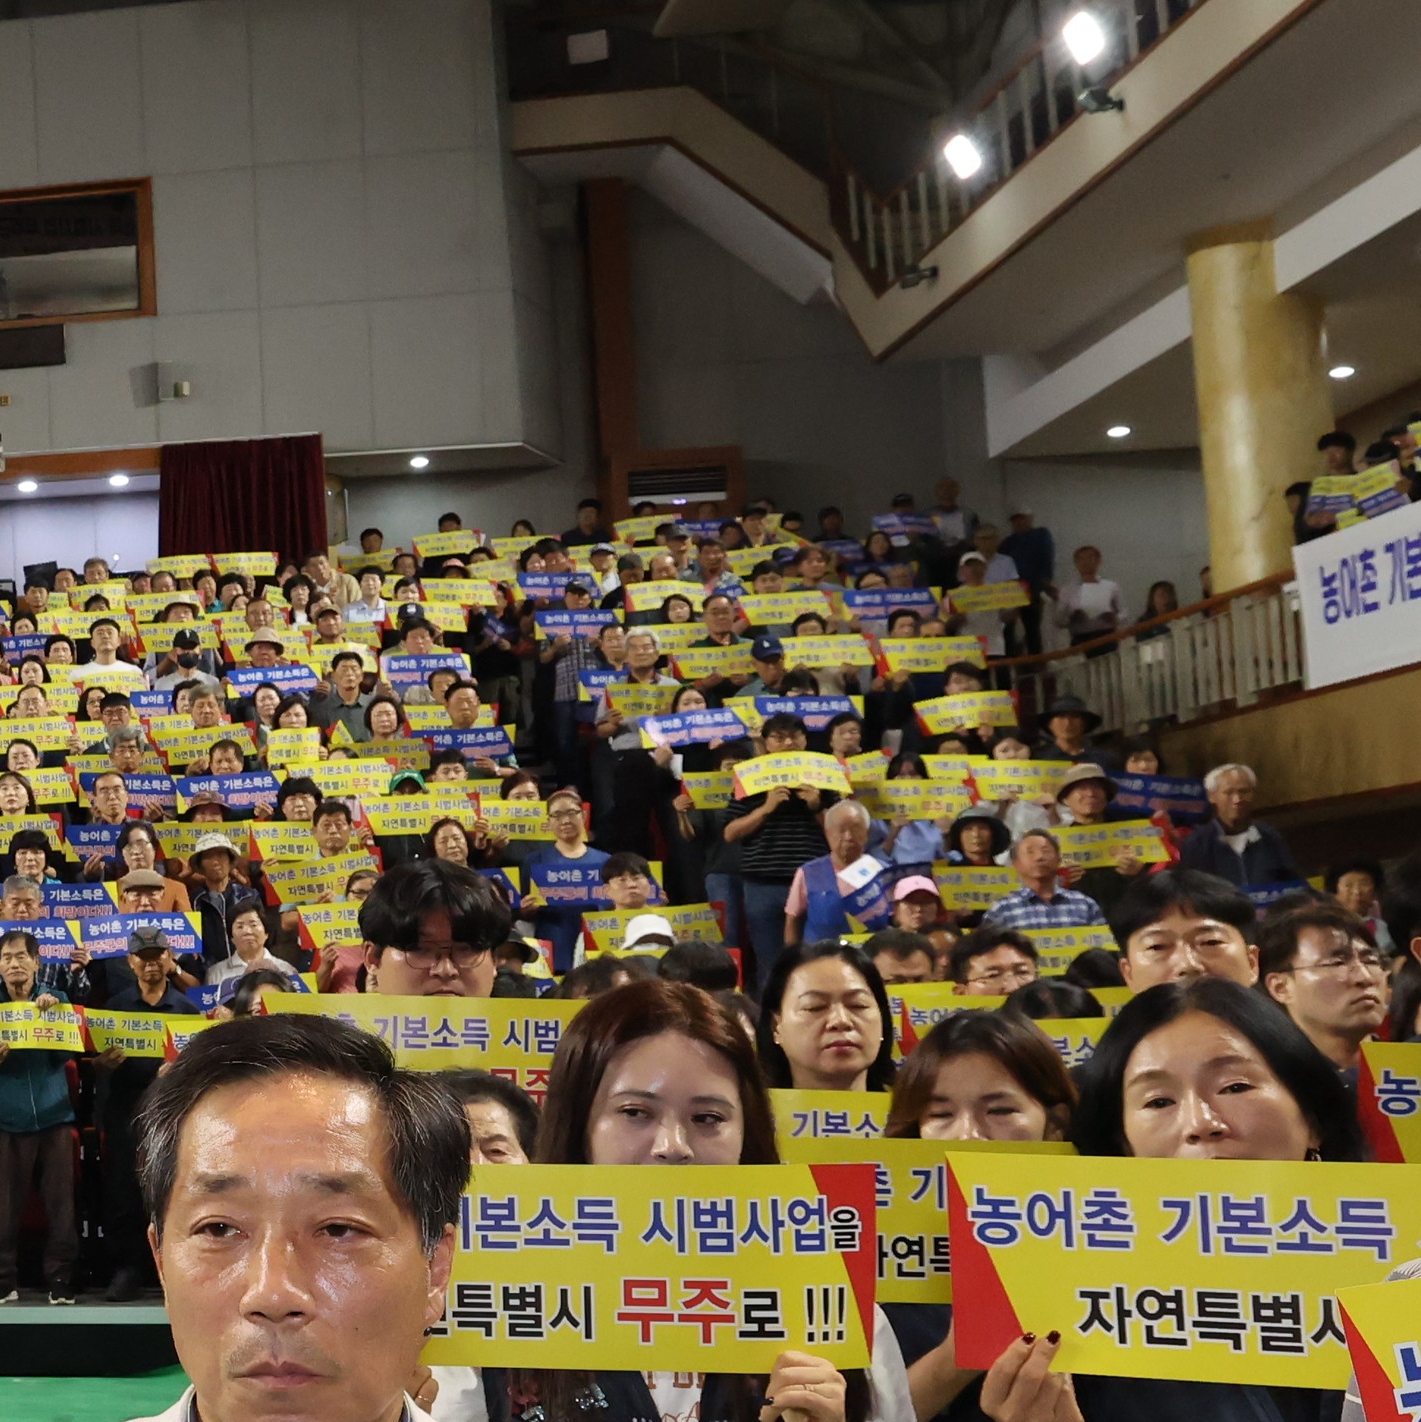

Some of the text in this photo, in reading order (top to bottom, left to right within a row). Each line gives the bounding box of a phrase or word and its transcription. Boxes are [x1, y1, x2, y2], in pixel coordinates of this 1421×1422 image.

[1319, 548, 1380, 625] 농어촌
[189, 777, 273, 793] 농어촌 기본소득은
[79, 831, 112, 842] 농어촌
[49, 889, 104, 901] 기본소득은
[302, 912, 332, 924] 농어촌
[89, 920, 123, 936] 농어촌
[85, 1016, 163, 1031] 농어촌 기본소득
[32, 1027, 65, 1043] 무주로
[373, 1015, 491, 1052] 기본소득
[641, 1195, 864, 1256] 시범사업을
[968, 1183, 1138, 1252] 농어촌
[1159, 1193, 1396, 1263] 기본소득
[615, 1276, 788, 1347] 무주로
[803, 1285, 848, 1345] !!!
